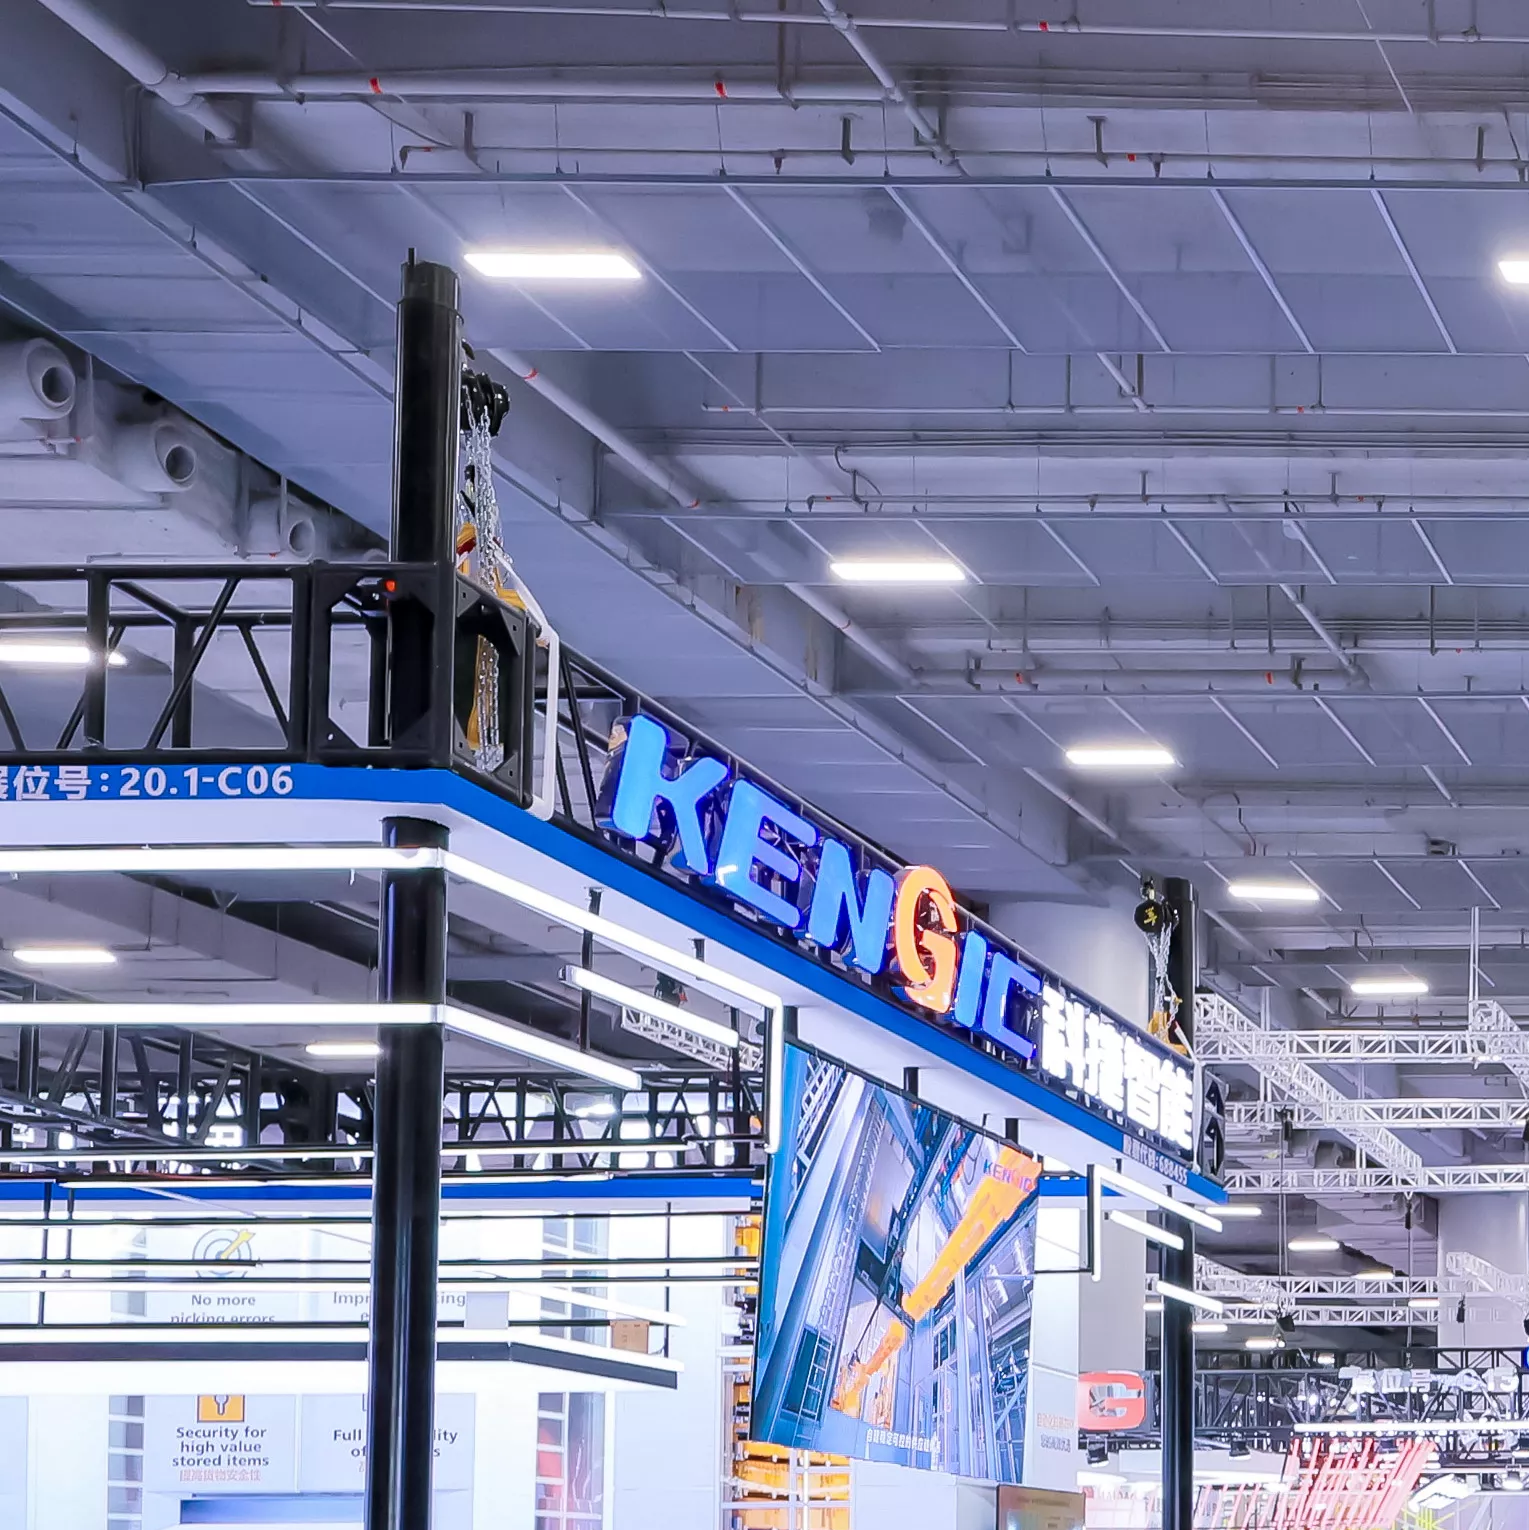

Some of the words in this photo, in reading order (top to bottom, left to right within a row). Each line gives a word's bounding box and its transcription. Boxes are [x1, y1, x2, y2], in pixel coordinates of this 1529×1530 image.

[0, 765, 294, 801] 位号:20.1-C06
[611, 713, 1042, 1060] KENGIC
[191, 1293, 213, 1307] No
[216, 1295, 256, 1307] more
[176, 1426, 239, 1441] Security
[243, 1425, 267, 1439] for
[180, 1440, 215, 1455] high
[220, 1440, 262, 1453] value
[172, 1455, 222, 1467] stored
[226, 1454, 270, 1467] items
